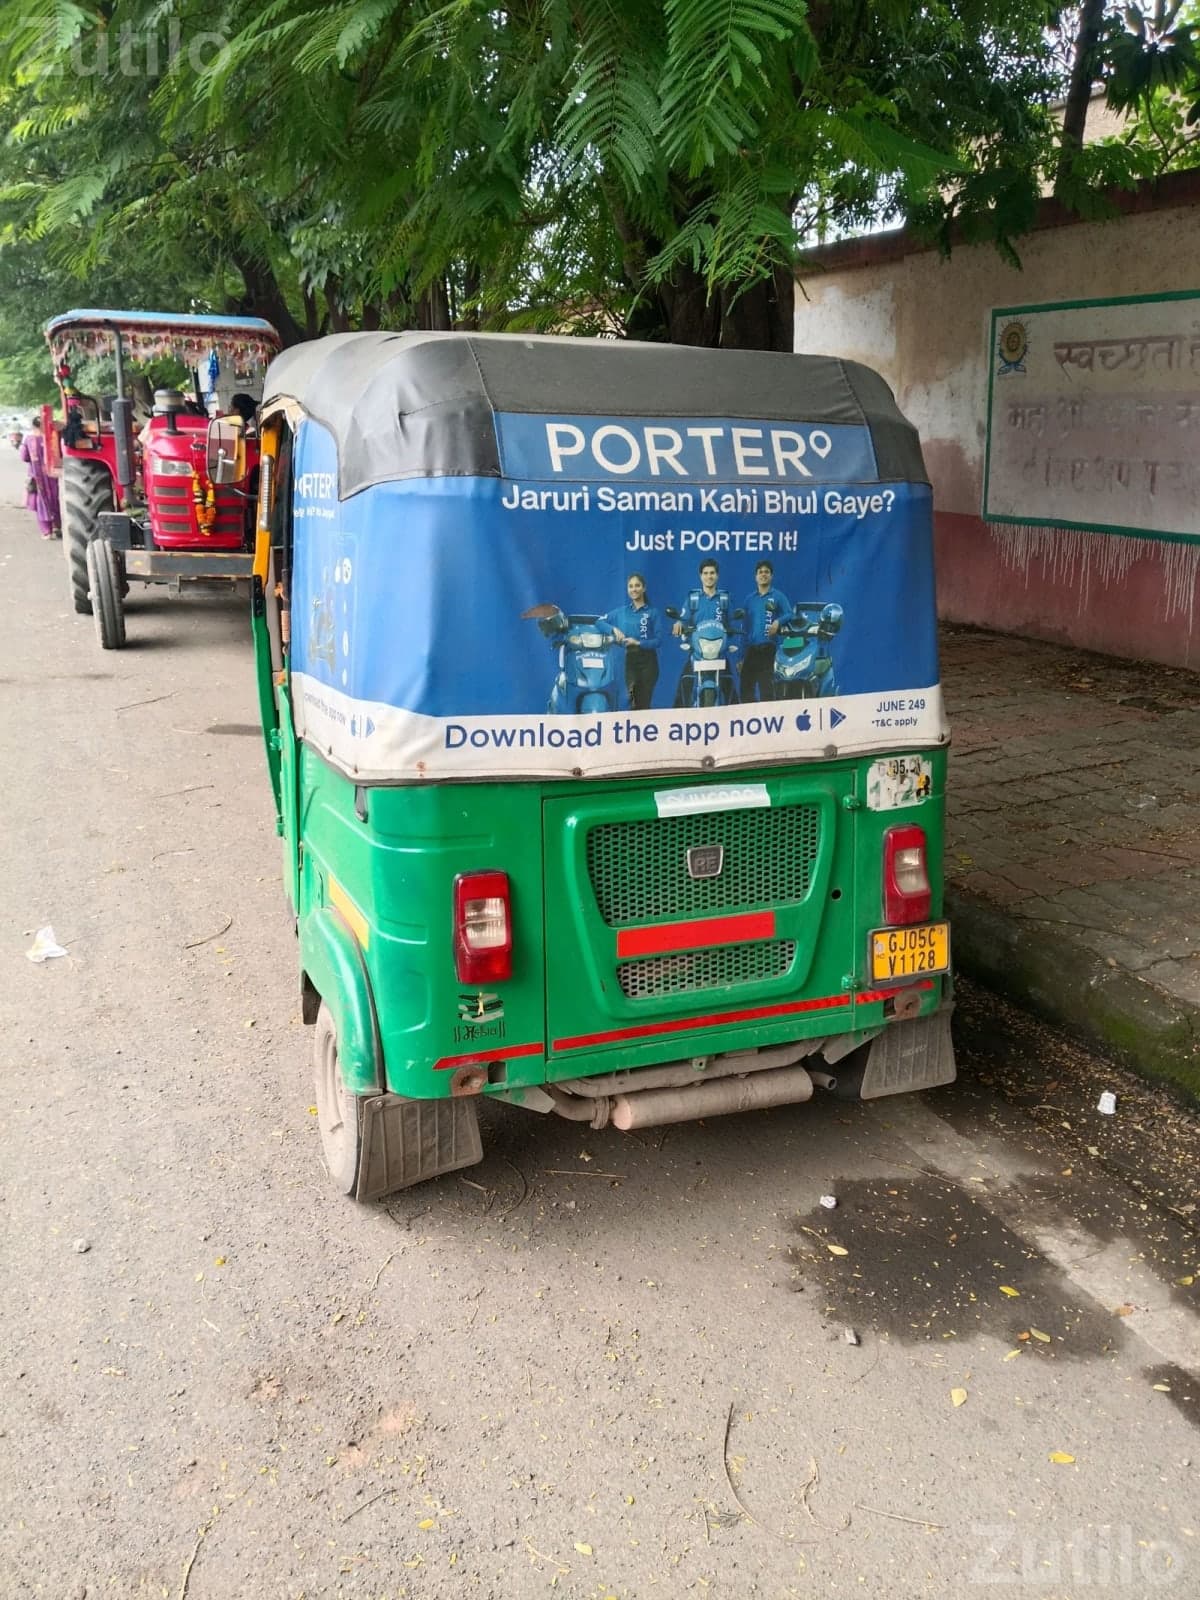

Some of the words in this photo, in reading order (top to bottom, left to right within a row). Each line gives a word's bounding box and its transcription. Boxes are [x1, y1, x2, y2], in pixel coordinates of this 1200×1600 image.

[545, 423, 812, 477] PORTER
[502, 485, 590, 511] Jaruri
[597, 487, 693, 512] Saman
[700, 488, 758, 513] Kahi
[764, 490, 818, 514] Bhul
[824, 490, 896, 519] Gaye?
[626, 530, 674, 551] Just
[680, 531, 773, 551] PORTER
[779, 531, 798, 551] It!
[876, 700, 905, 712] JUNE
[908, 699, 926, 710] 249
[445, 722, 602, 748] Download
[613, 719, 659, 744] the
[668, 722, 720, 746] app
[730, 716, 784, 737] now
[894, 717, 918, 727] apply
[888, 927, 936, 953] GJ05C
[888, 949, 936, 977] V1128
